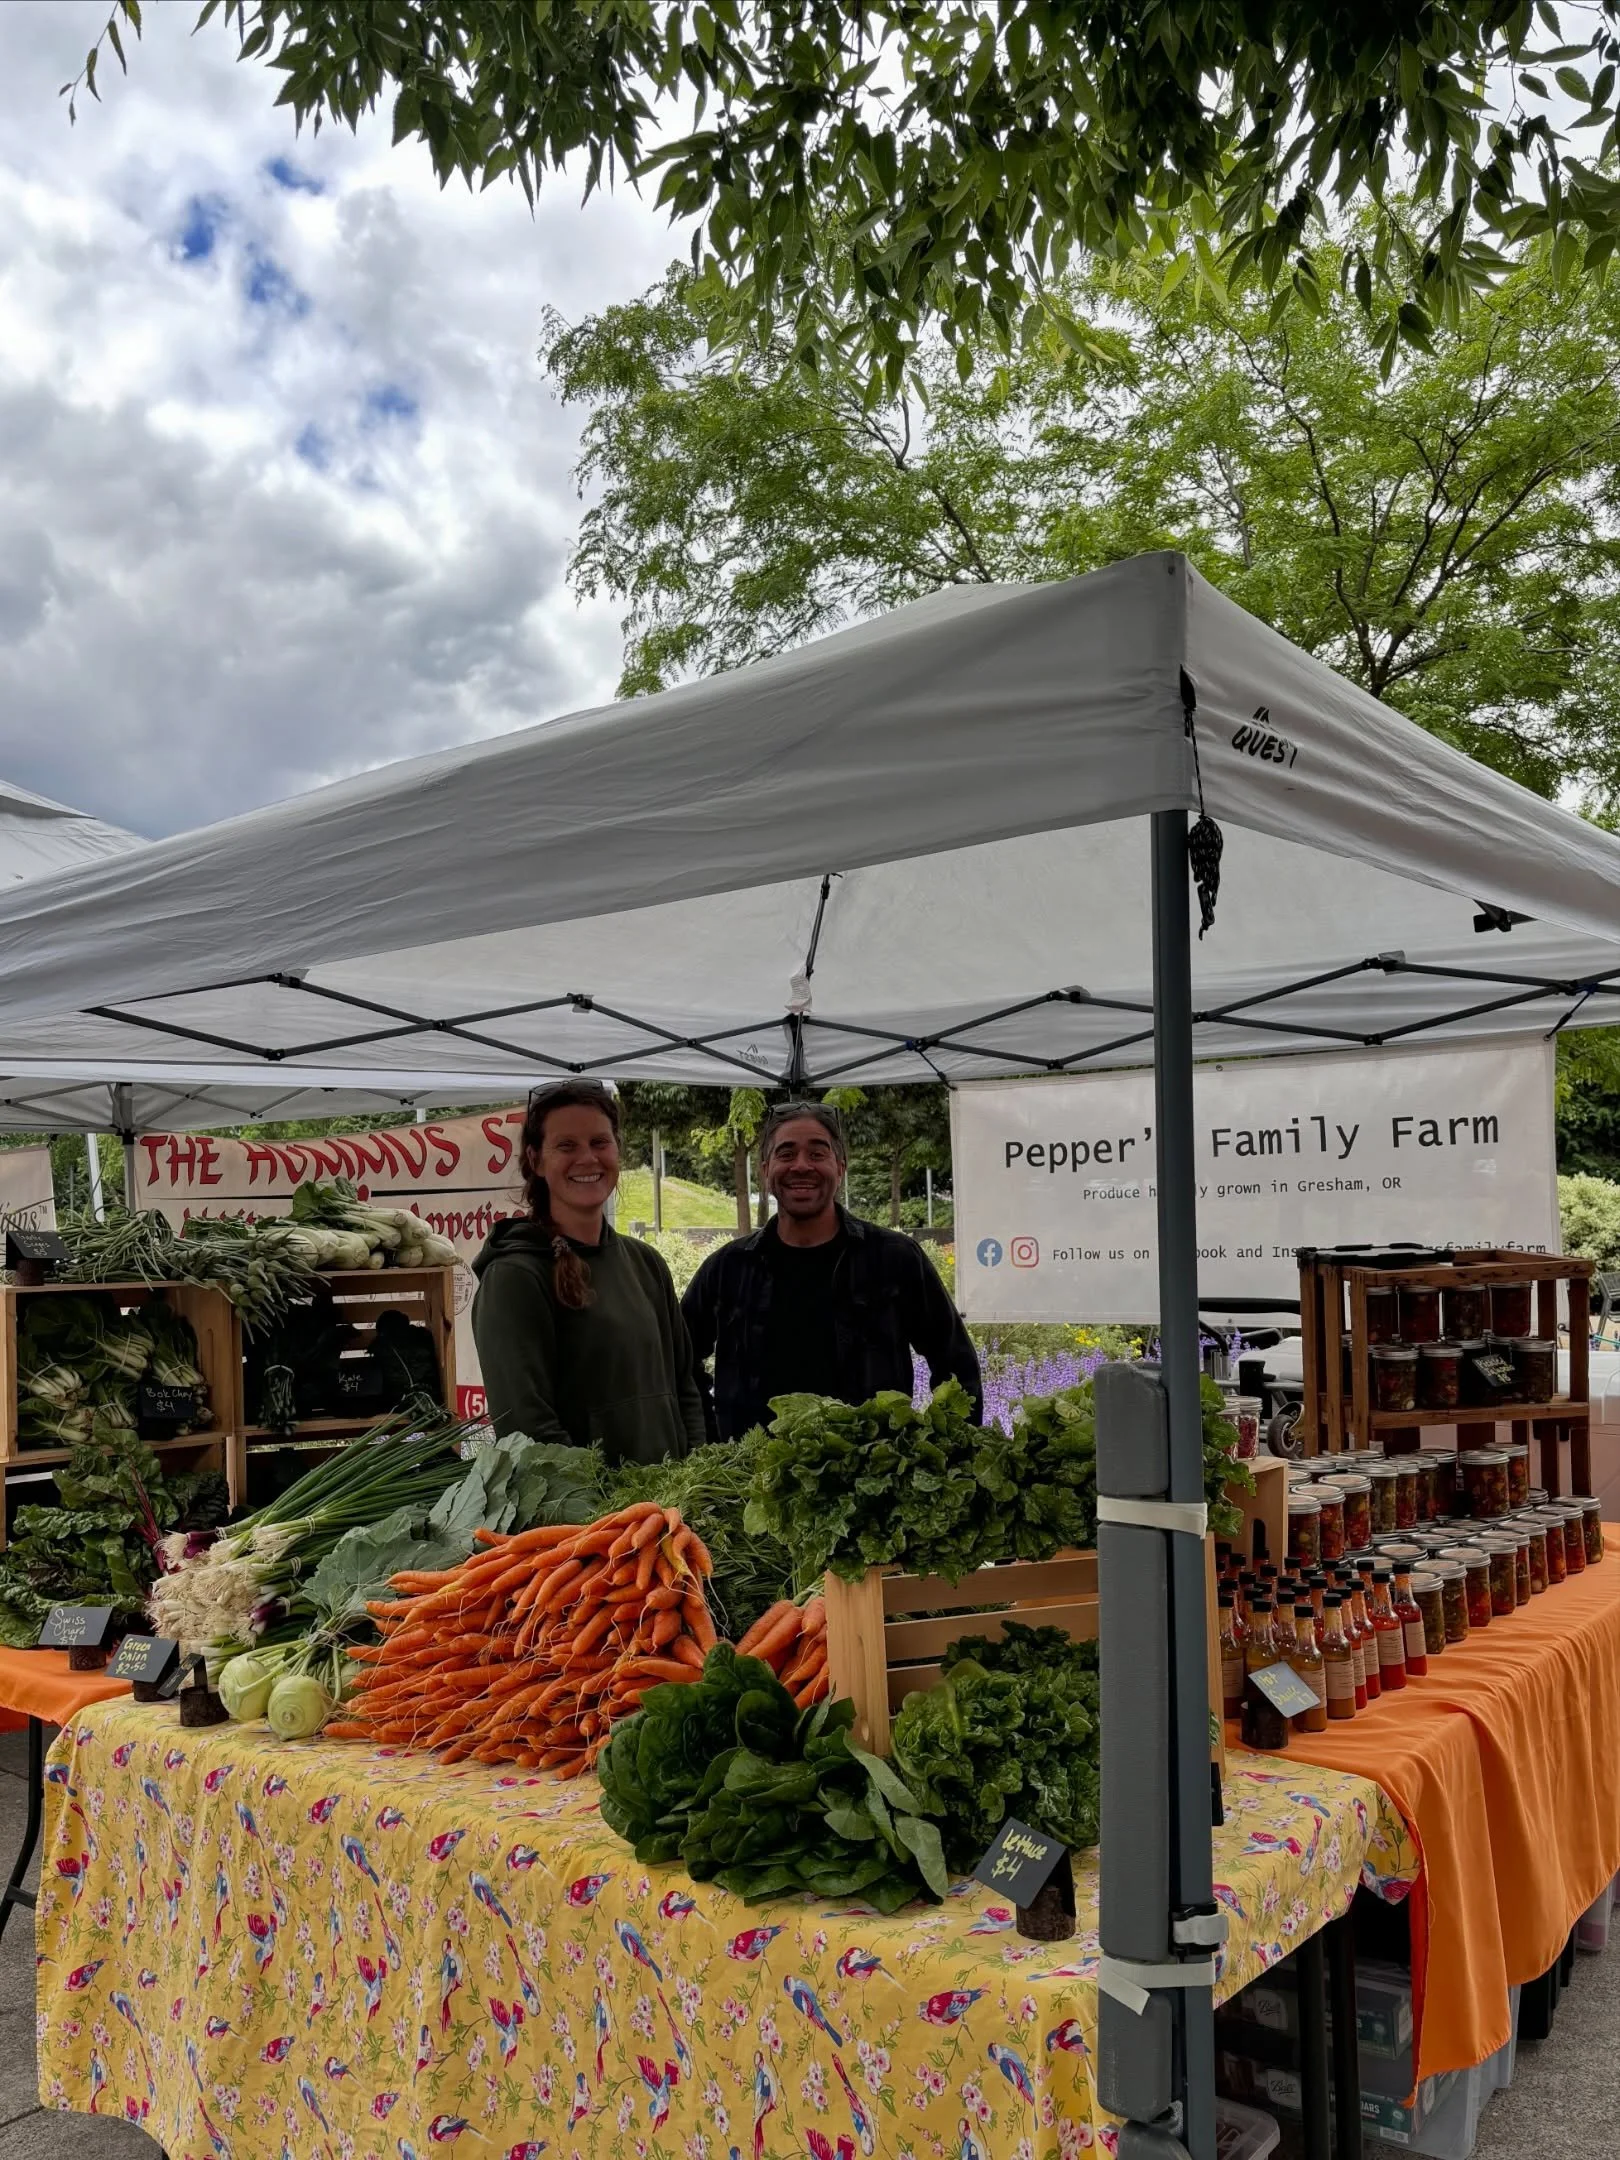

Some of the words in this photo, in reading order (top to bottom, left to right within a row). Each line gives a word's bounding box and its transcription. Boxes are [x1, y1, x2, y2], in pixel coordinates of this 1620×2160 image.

[1231, 724, 1298, 768] QUEST
[1004, 1127, 1152, 1173] Pepper'
[1211, 1116, 1360, 1159] Family
[1392, 1113, 1499, 1148] Farm
[139, 1135, 223, 1187] THE
[238, 1126, 460, 1186] HUMMUS
[1083, 1186, 1140, 1200] Produce
[1217, 1183, 1261, 1198] grown
[1271, 1179, 1288, 1193] in
[1297, 1177, 1371, 1192] Gresham,
[1382, 1176, 1402, 1189] OR
[1053, 1248, 1101, 1260] Follow
[1108, 1250, 1125, 1260] us
[1133, 1249, 1150, 1260] on
[1236, 1245, 1263, 1258] and
[145, 1387, 171, 1398] Bok
[156, 1400, 175, 1413] $4
[464, 1390, 488, 1419] (5
[50, 1608, 86, 1626] Swiss
[53, 1624, 86, 1637] Chard
[59, 1635, 78, 1645] $4
[124, 1638, 152, 1651] Green
[118, 1652, 148, 1661] Onion
[1001, 1828, 1048, 1860] Lettuce
[991, 1853, 1024, 1882] $4
